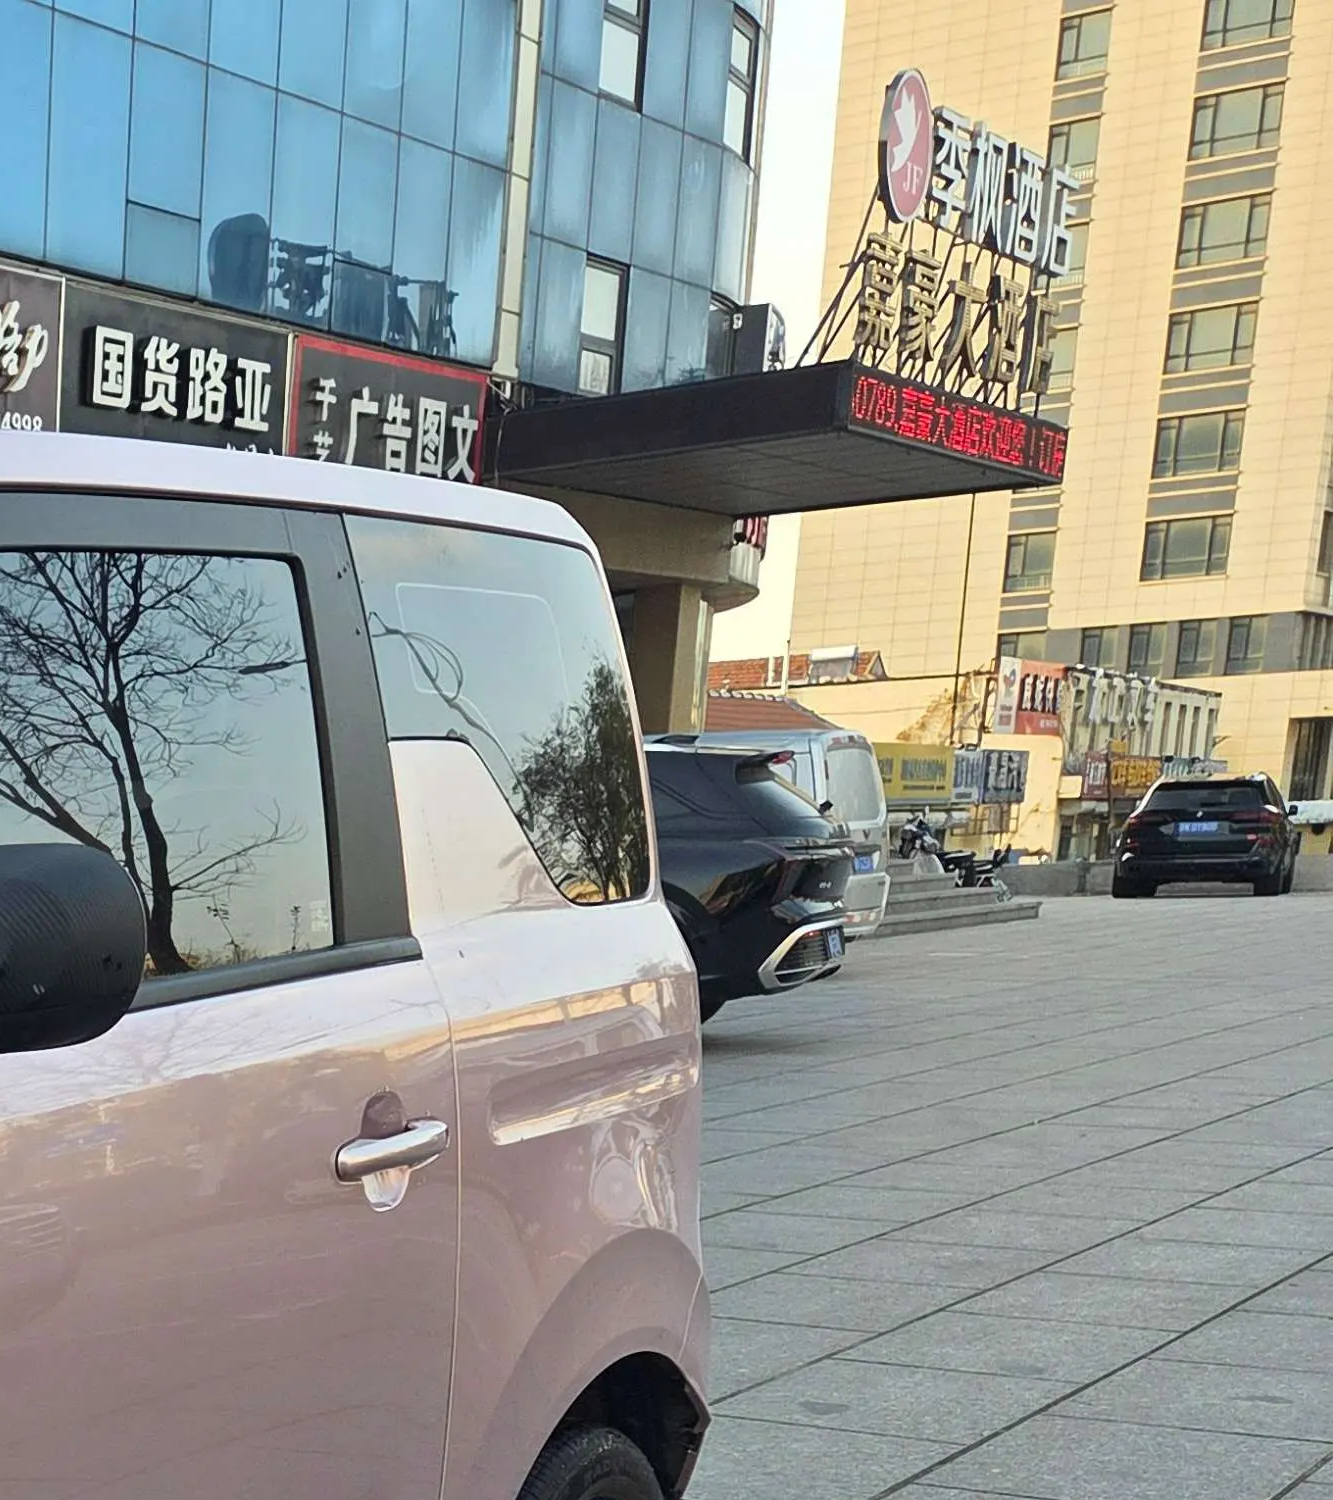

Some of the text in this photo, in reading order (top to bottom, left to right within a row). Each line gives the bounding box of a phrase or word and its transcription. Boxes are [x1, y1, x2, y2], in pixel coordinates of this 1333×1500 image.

[902, 160, 923, 196] JF
[933, 105, 1080, 277] 季枫酒店
[91, 324, 272, 433] 国货路亚
[343, 386, 480, 484] 广告图文
